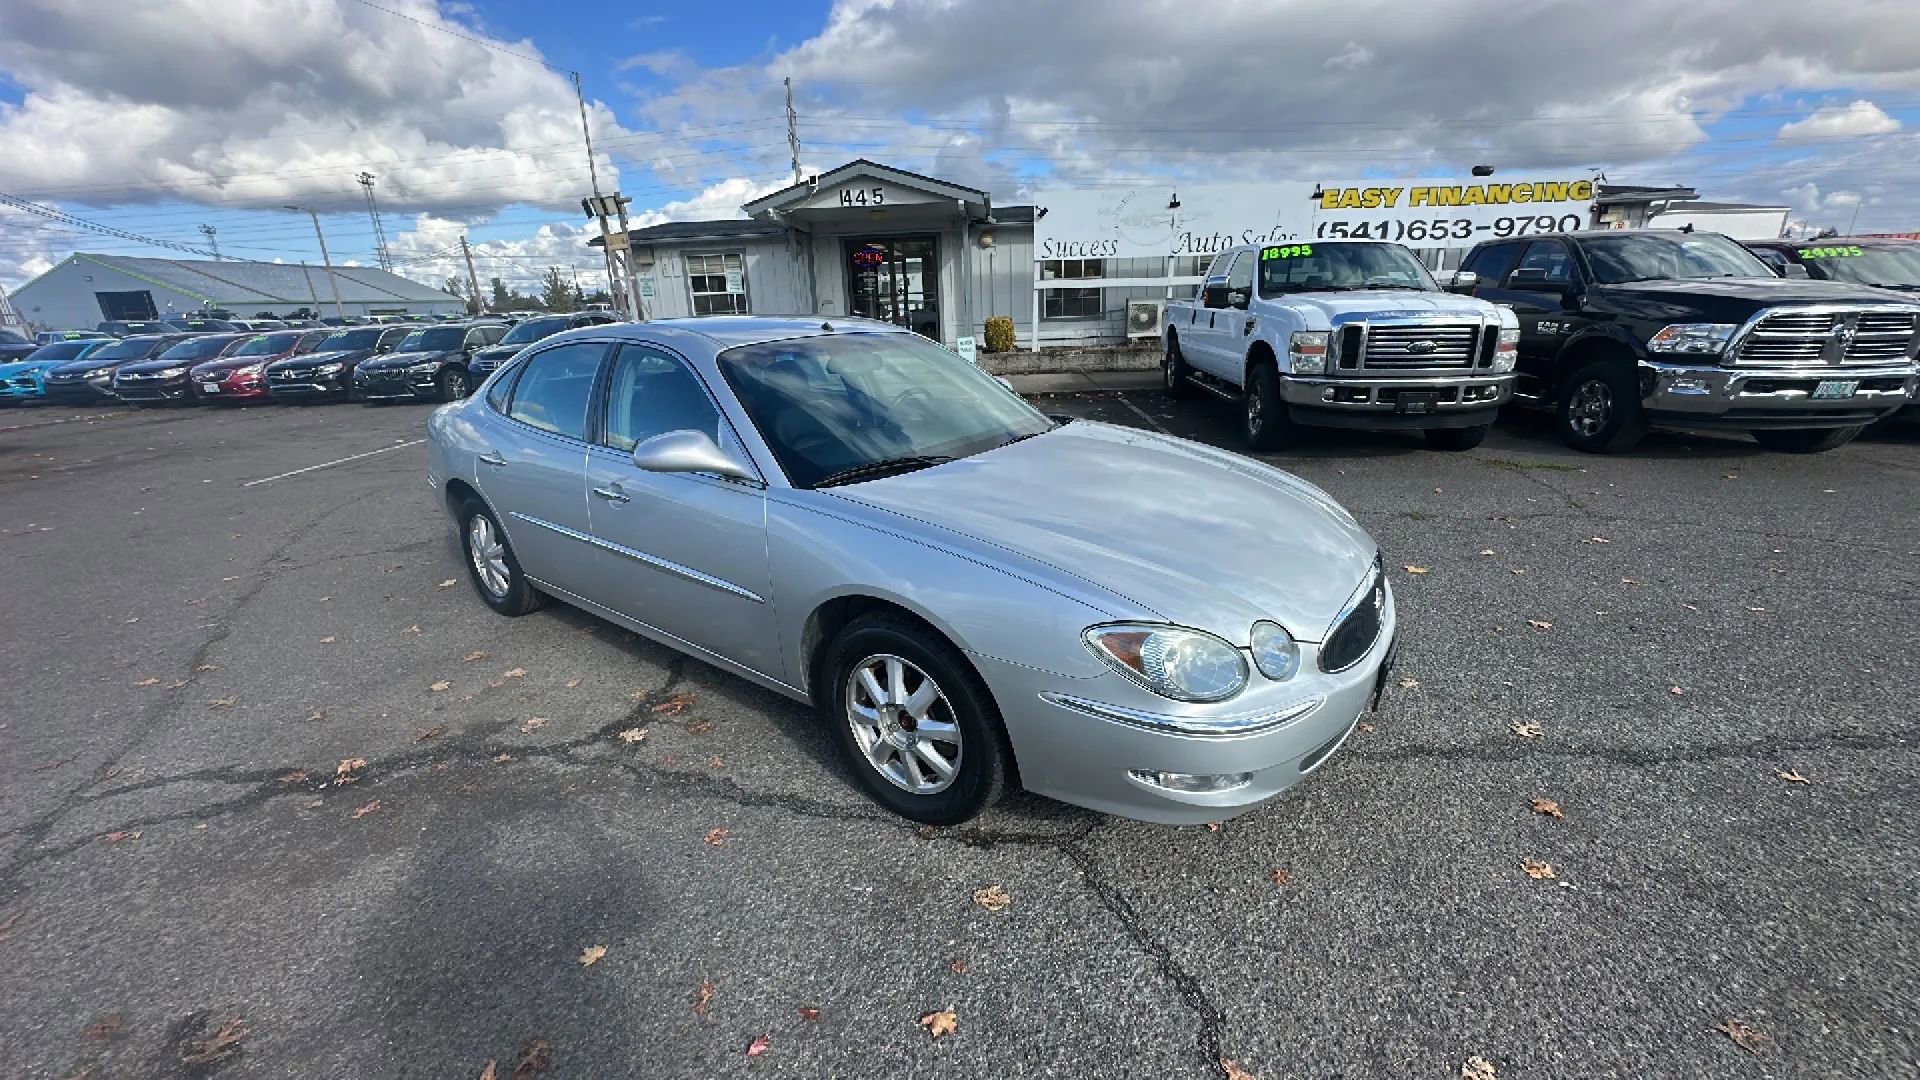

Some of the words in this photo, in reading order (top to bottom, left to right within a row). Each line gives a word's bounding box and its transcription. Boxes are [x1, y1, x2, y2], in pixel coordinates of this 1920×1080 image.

[840, 187, 884, 207] 1445
[1320, 186, 1403, 209] EASY
[1409, 180, 1593, 207] FINANCING
[1316, 214, 1581, 241] (541)653-9790
[1041, 237, 1119, 260] Success
[1171, 231, 1233, 255] Auto
[1262, 244, 1313, 261] 18995
